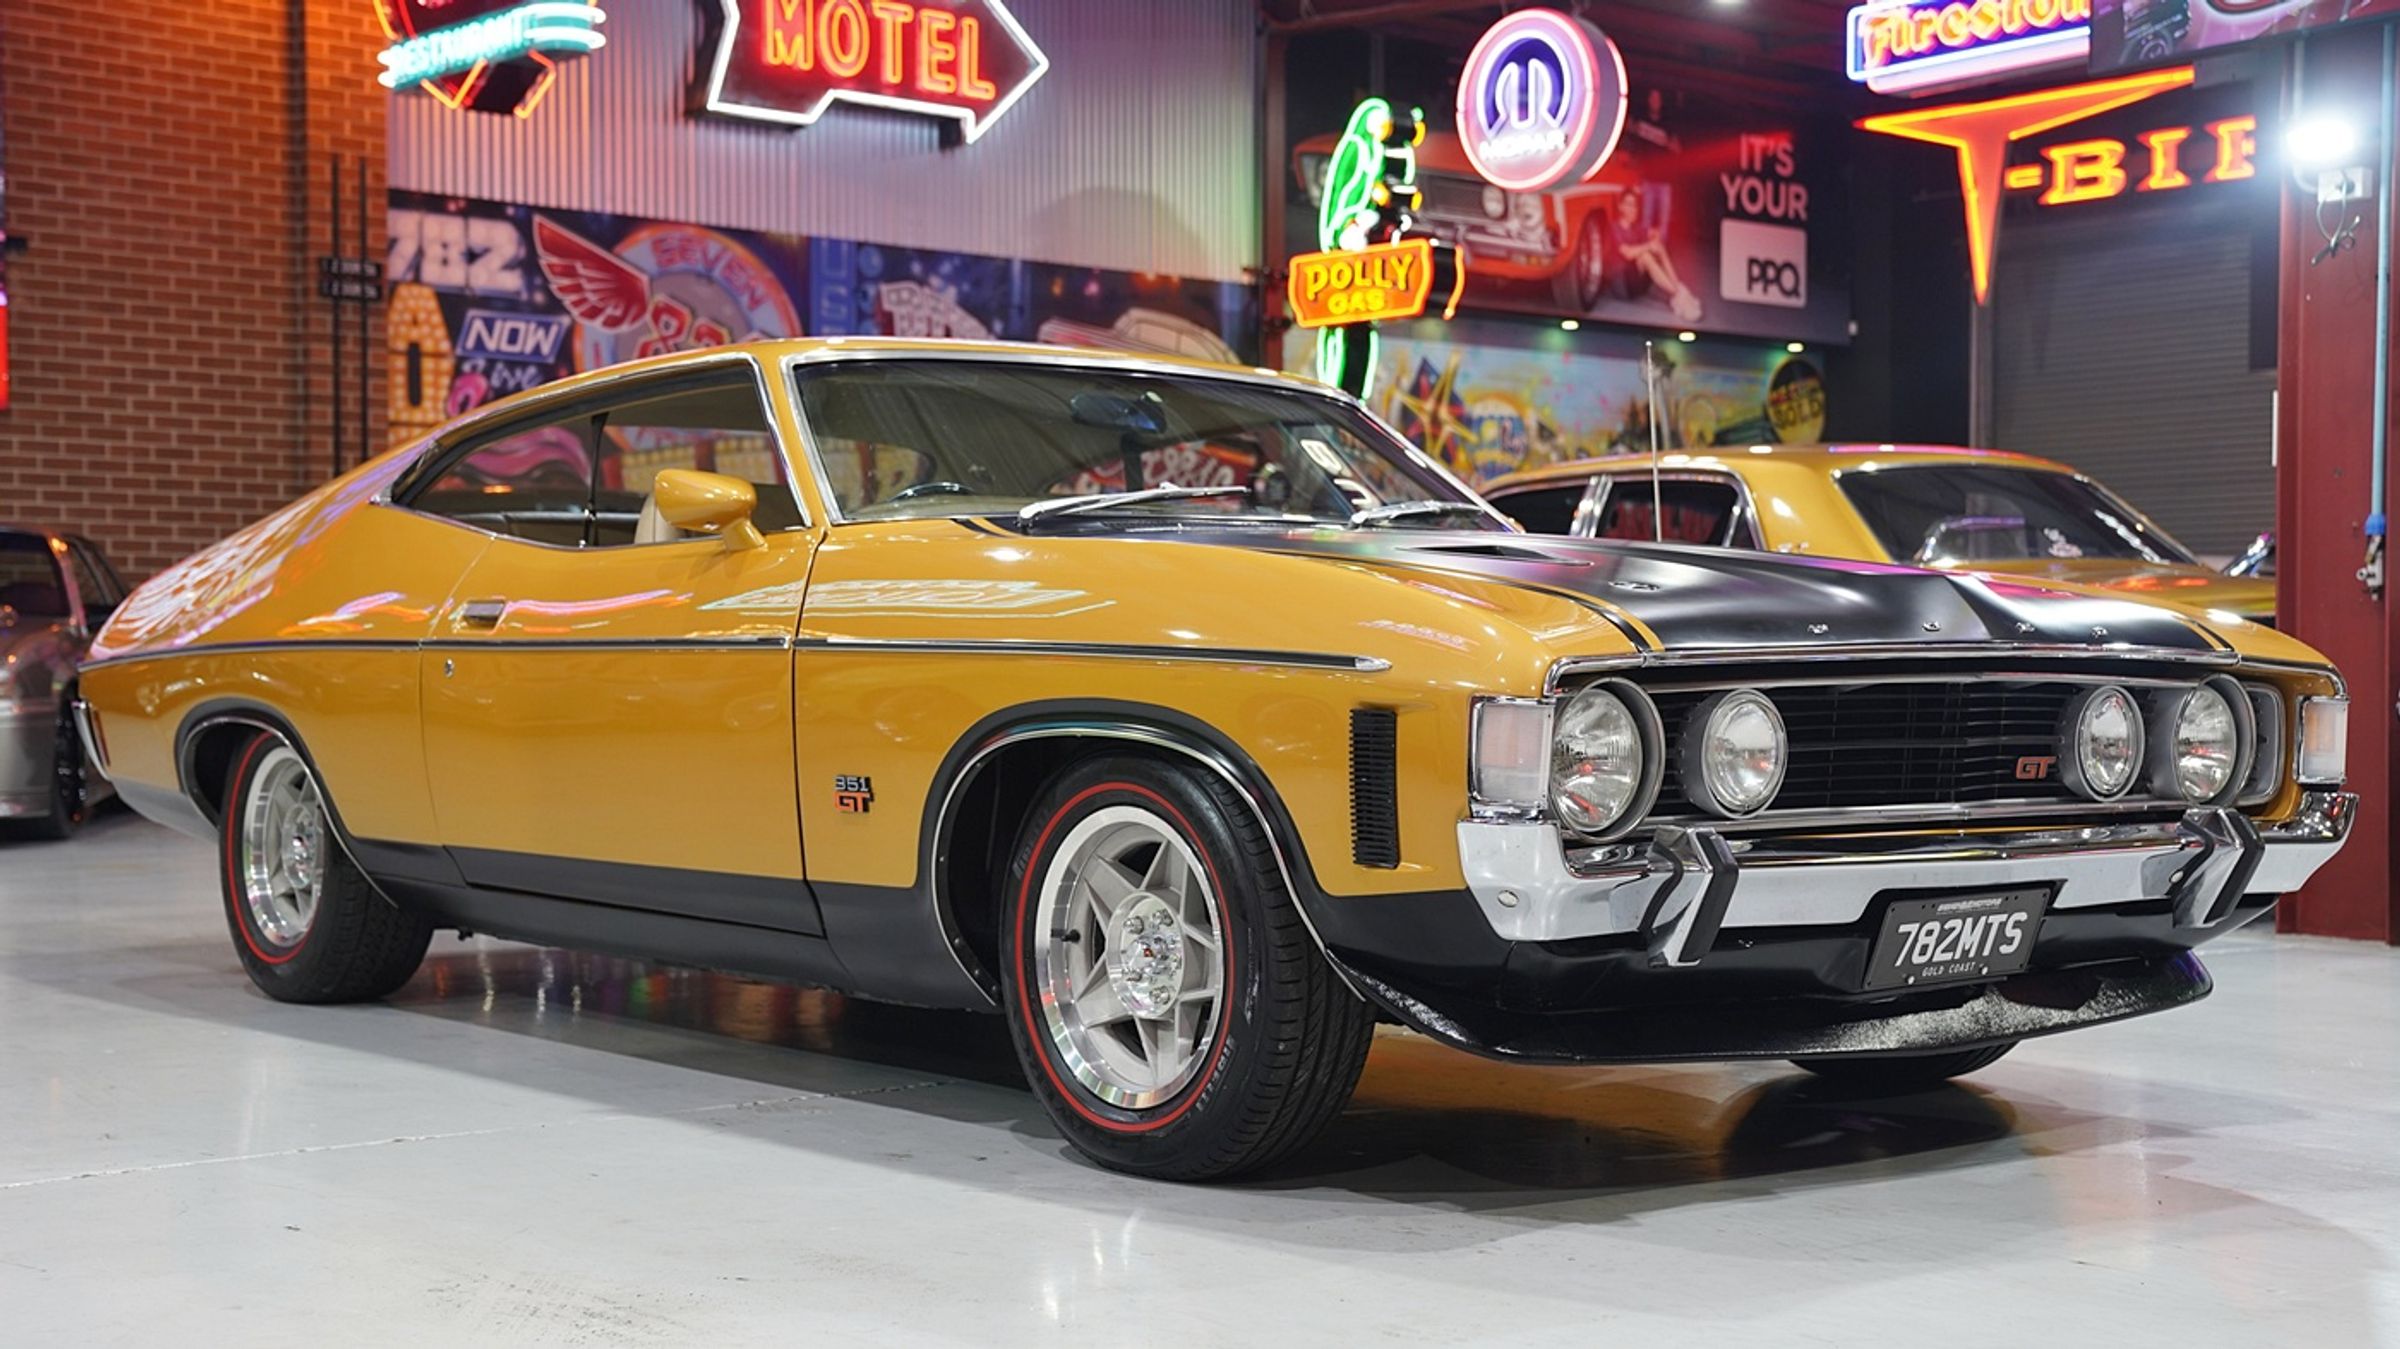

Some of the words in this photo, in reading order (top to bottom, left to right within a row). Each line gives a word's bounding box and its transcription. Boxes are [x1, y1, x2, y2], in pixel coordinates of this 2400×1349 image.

[764, 0, 996, 100] MOTEL
[1740, 132, 1795, 177] IT'S
[1720, 171, 1808, 221] YOUR
[387, 209, 521, 300] 782
[1303, 252, 1415, 301] POLLY
[1746, 256, 1802, 298] PPQ
[1327, 287, 1385, 315] GAS
[464, 317, 559, 357] NOW
[833, 775, 869, 791] 351
[2016, 756, 2057, 779] GT
[832, 791, 870, 812] GT
[1894, 912, 2028, 966] 782MTS
[1921, 965, 1945, 977] GOLD
[1949, 961, 1976, 974] COAST
